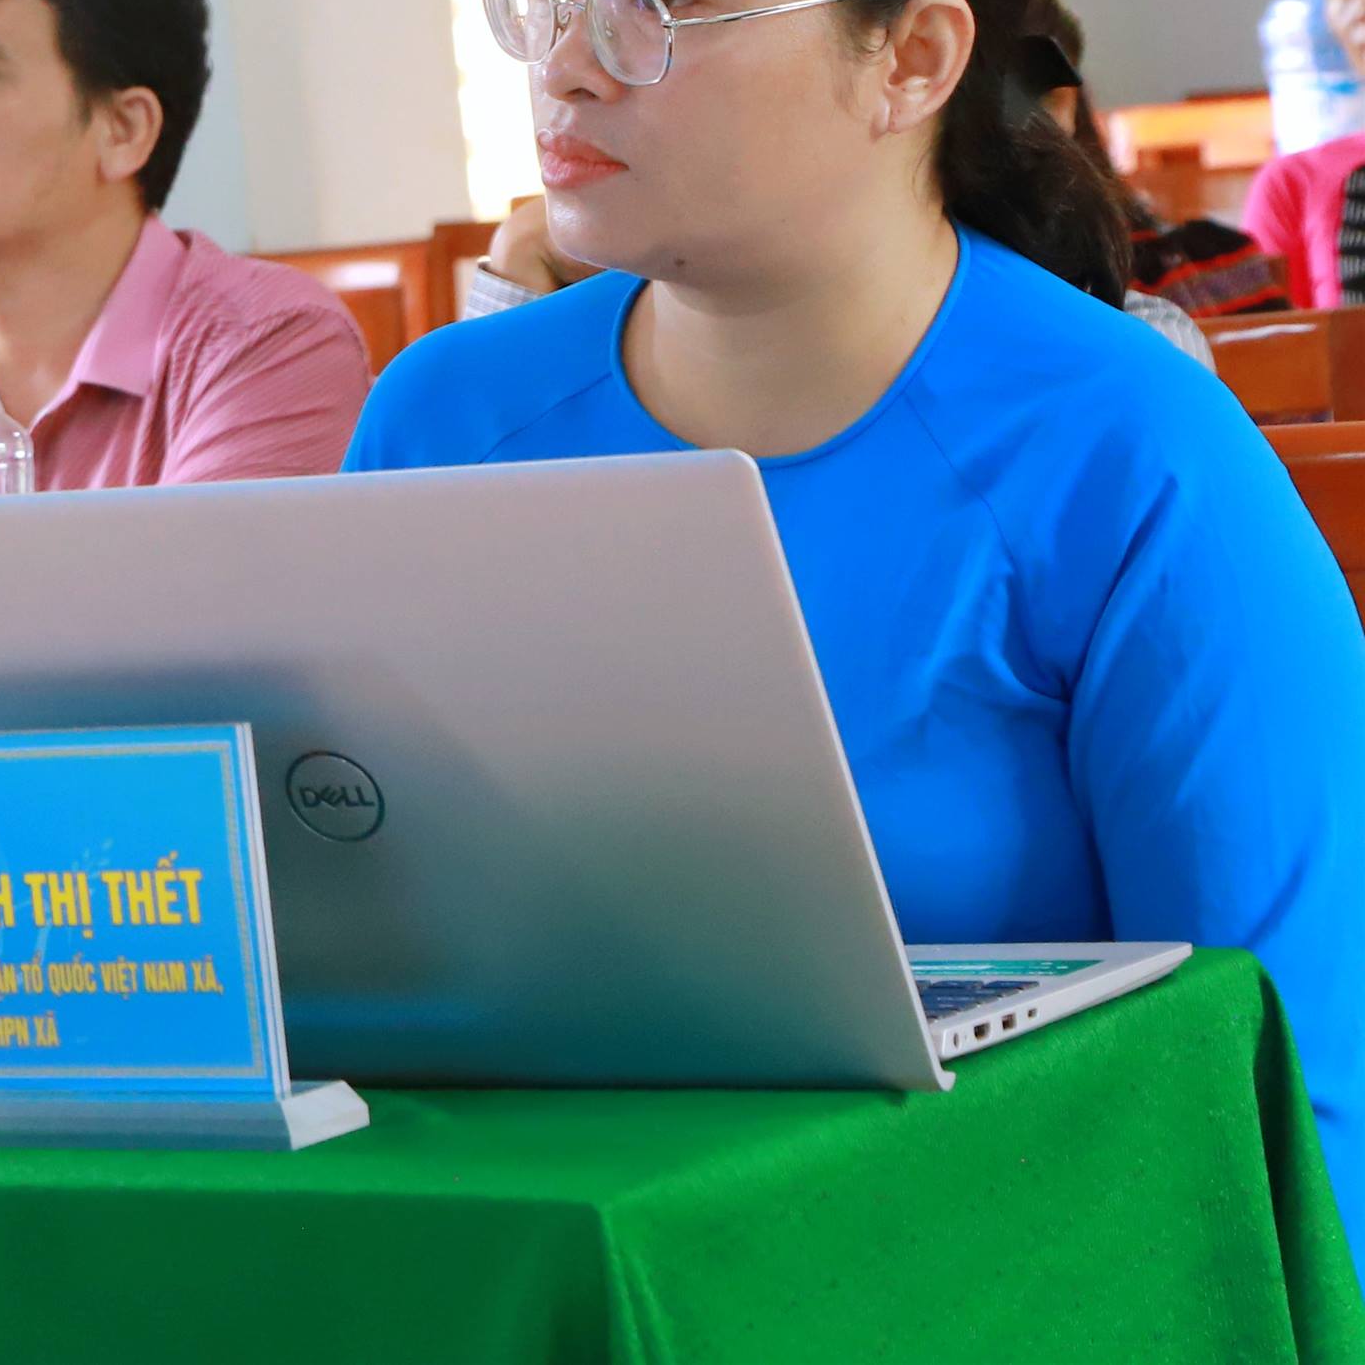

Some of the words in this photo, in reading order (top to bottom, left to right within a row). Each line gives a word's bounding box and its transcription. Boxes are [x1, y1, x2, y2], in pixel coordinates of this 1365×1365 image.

[299, 786, 375, 808] DELL
[24, 871, 94, 939] THỊ
[101, 851, 203, 925] THẾT
[20, 950, 44, 994] TỔ
[48, 951, 97, 996] QUỐC
[100, 956, 138, 1001] VIỆT
[143, 962, 188, 993] NAM
[191, 954, 224, 996] XÃ,
[33, 1010, 60, 1047] XÃ
